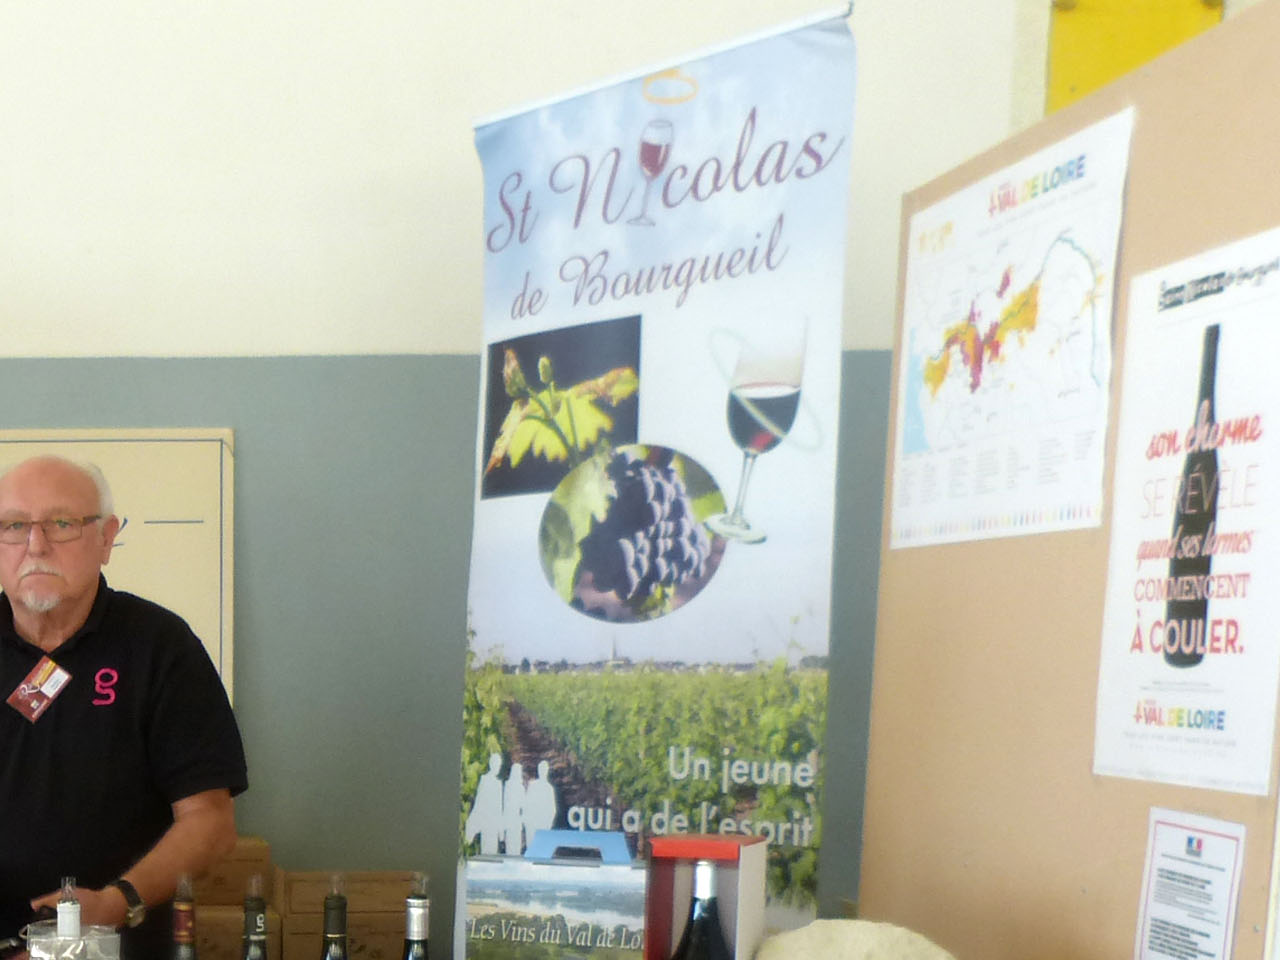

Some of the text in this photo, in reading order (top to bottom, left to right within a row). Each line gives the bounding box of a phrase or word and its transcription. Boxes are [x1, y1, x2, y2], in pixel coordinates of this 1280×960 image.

[486, 171, 539, 254] St
[510, 214, 790, 320] de Bourgueil
[1146, 399, 1263, 460] son charme
[1136, 521, 1254, 570] quand ses larmes
[1133, 573, 1251, 602] COMMENCENT
[1130, 610, 1245, 655] À COULER.
[1187, 709, 1227, 731] LOIRE
[669, 746, 815, 794] Un jeune
[567, 798, 612, 833] qui
[622, 811, 640, 833] a
[650, 800, 688, 835] de
[470, 919, 496, 940] Les
[502, 921, 536, 943] Vins
[540, 922, 561, 944] du
[567, 924, 593, 948] Val
[596, 926, 616, 948] de
